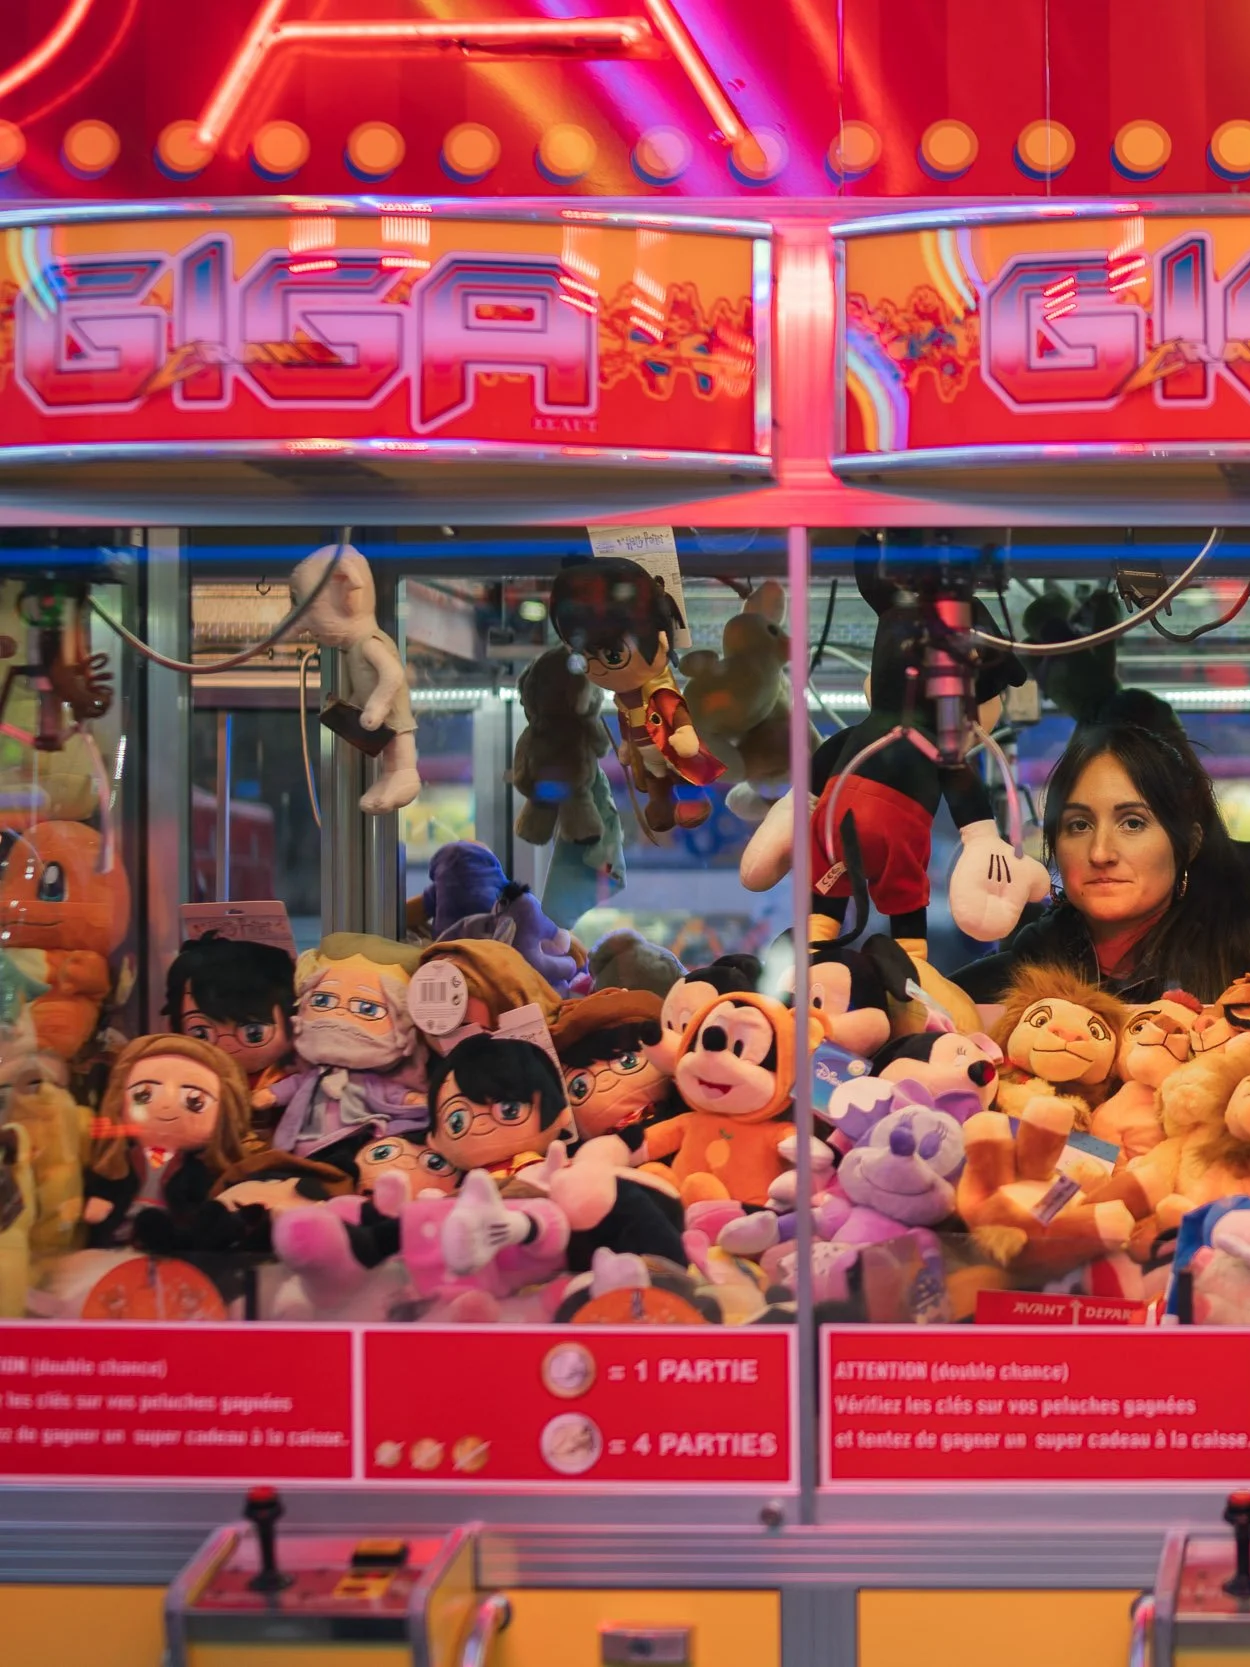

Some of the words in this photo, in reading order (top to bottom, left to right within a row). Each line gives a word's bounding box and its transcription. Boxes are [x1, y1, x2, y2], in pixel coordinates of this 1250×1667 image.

[15, 234, 598, 434] GIGA
[1013, 1302, 1065, 1316] AVANT
[634, 1359, 648, 1382] 1
[658, 1358, 759, 1383] PARTIE
[834, 1361, 928, 1381] ATTENTION
[931, 1361, 996, 1383] (double
[999, 1361, 1069, 1384] chance)
[835, 1395, 902, 1415] Vérifiez
[905, 1396, 932, 1415] les
[934, 1395, 973, 1415] clés
[975, 1399, 1004, 1415] sur
[1007, 1399, 1038, 1415] vos
[1041, 1396, 1120, 1418] peluches
[1123, 1395, 1196, 1419] gagnées
[632, 1433, 652, 1456] 4
[658, 1432, 778, 1457] PARTIES
[834, 1430, 854, 1448] et
[856, 1431, 912, 1448] tentez
[914, 1430, 938, 1448] de
[940, 1432, 1001, 1452] gagner
[1004, 1432, 1027, 1448] un
[1034, 1432, 1084, 1451] super
[1087, 1430, 1151, 1449] cadeau
[1170, 1430, 1188, 1448] la
